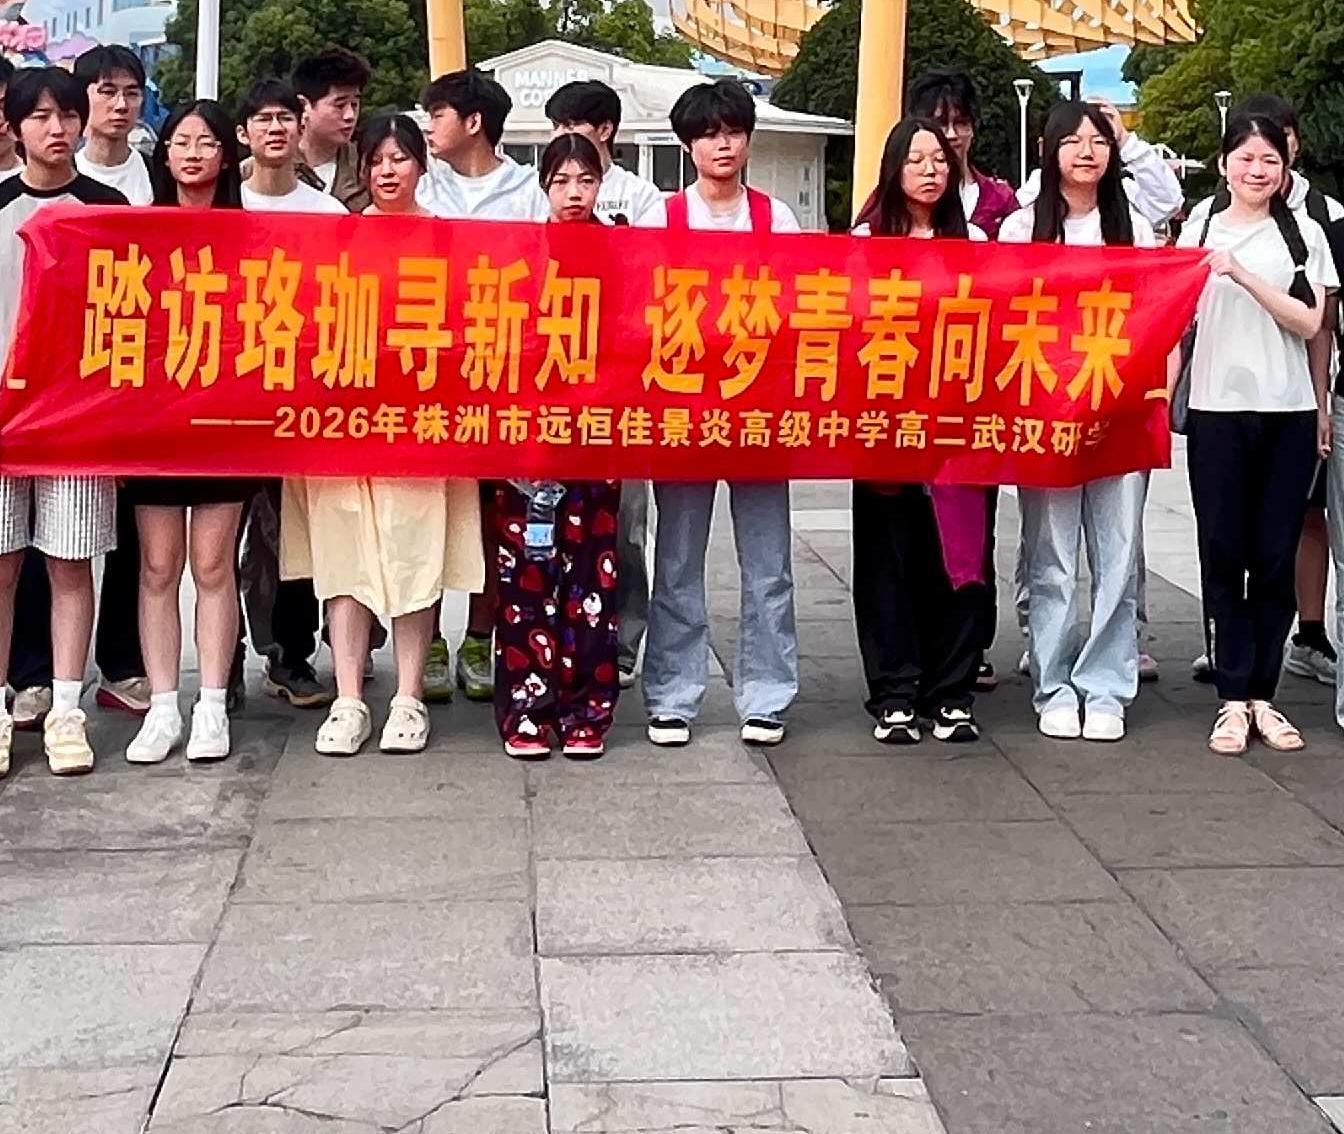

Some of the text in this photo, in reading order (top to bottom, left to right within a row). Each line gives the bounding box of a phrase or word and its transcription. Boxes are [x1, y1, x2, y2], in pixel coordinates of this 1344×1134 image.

[79, 242, 1133, 411] 踏访珞珈寻新知 逐梦青春向未来
